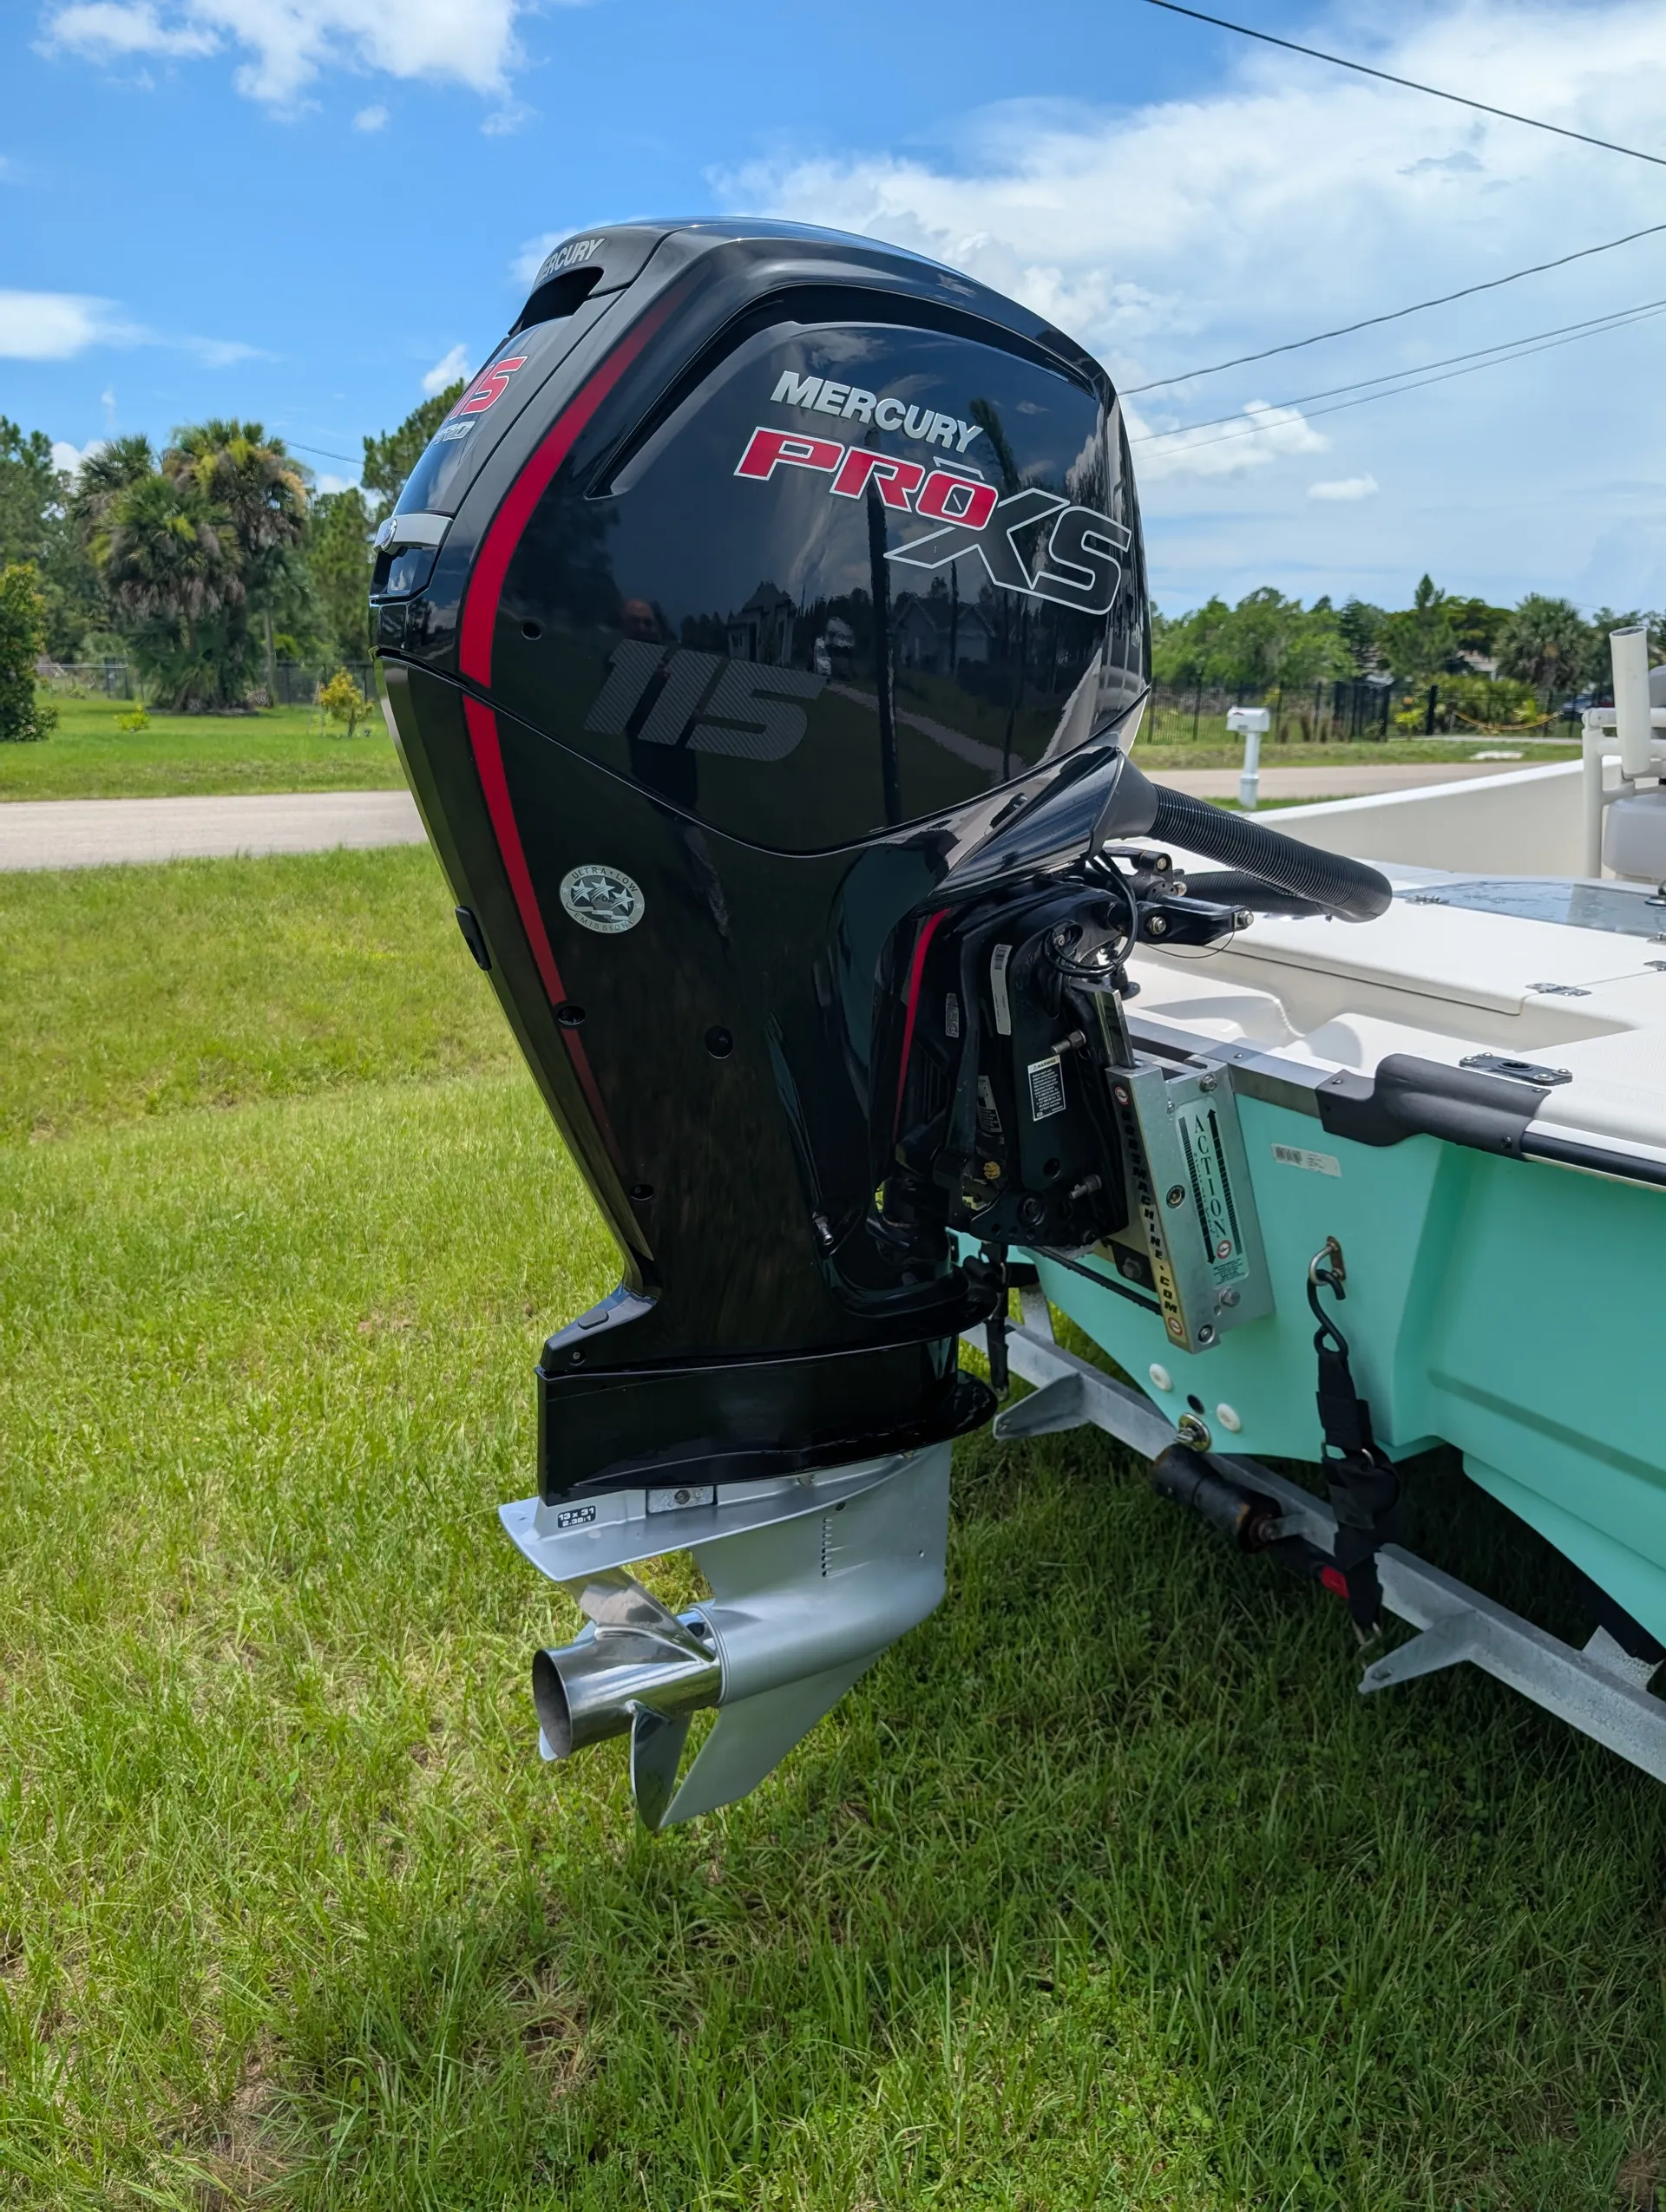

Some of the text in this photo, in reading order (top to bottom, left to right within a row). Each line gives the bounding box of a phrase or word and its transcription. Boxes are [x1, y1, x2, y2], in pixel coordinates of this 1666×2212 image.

[533, 238, 606, 284] ERCURY
[443, 356, 528, 422] 15
[770, 370, 984, 454] MERCURY
[732, 426, 1132, 615] PRO XS
[582, 638, 828, 762] 115
[572, 867, 638, 893] ULTRA LOW
[574, 913, 628, 932] EMISSION
[1038, 1058, 1057, 1068] WARNING
[1195, 1115, 1226, 1238] ACTION
[558, 1512, 571, 1521] 13
[580, 1507, 594, 1516] 31
